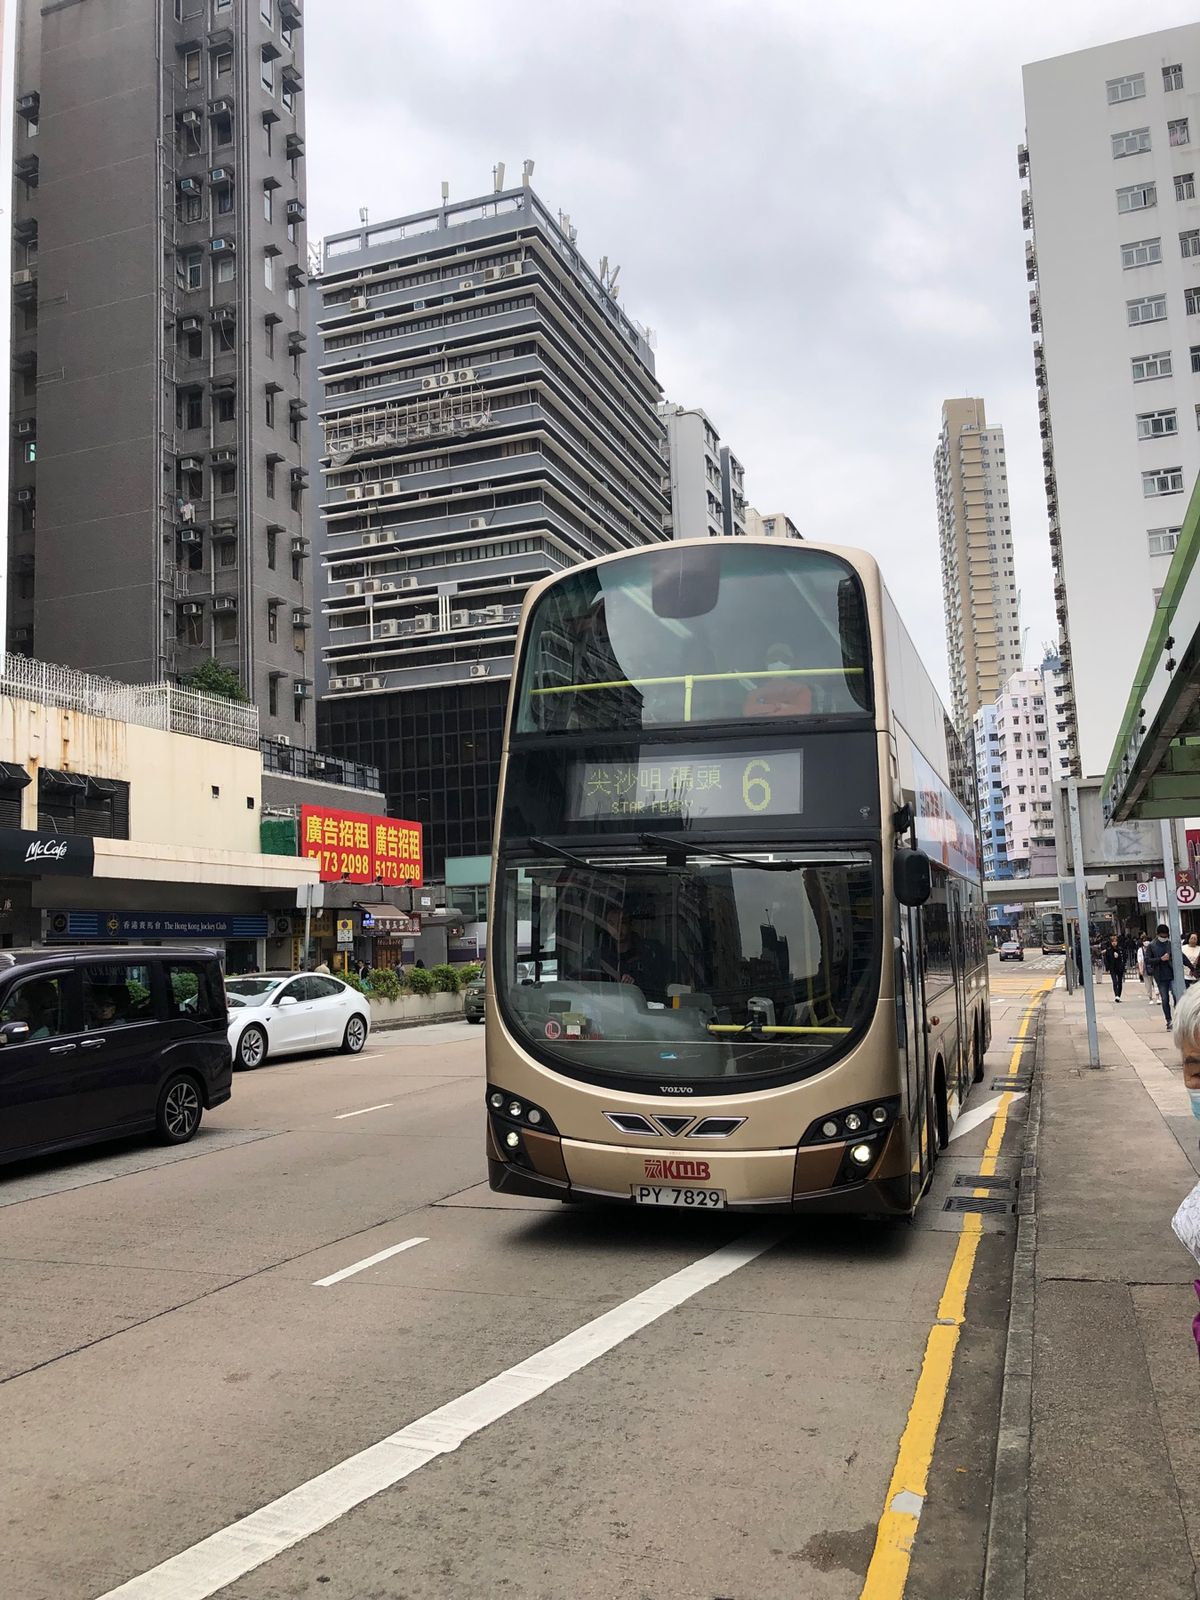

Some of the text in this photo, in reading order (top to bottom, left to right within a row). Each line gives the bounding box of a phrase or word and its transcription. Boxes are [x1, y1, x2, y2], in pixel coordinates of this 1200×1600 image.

[742, 759, 771, 812] 6
[611, 800, 645, 816] STAR
[306, 815, 369, 849] 廣告招租
[375, 824, 420, 860] 廣告招租
[341, 853, 369, 874] 2098
[375, 860, 420, 880] 5173 2098
[164, 921, 174, 930] The
[660, 1086, 693, 1094] VOLVO
[639, 1187, 720, 1207] PY 7829
